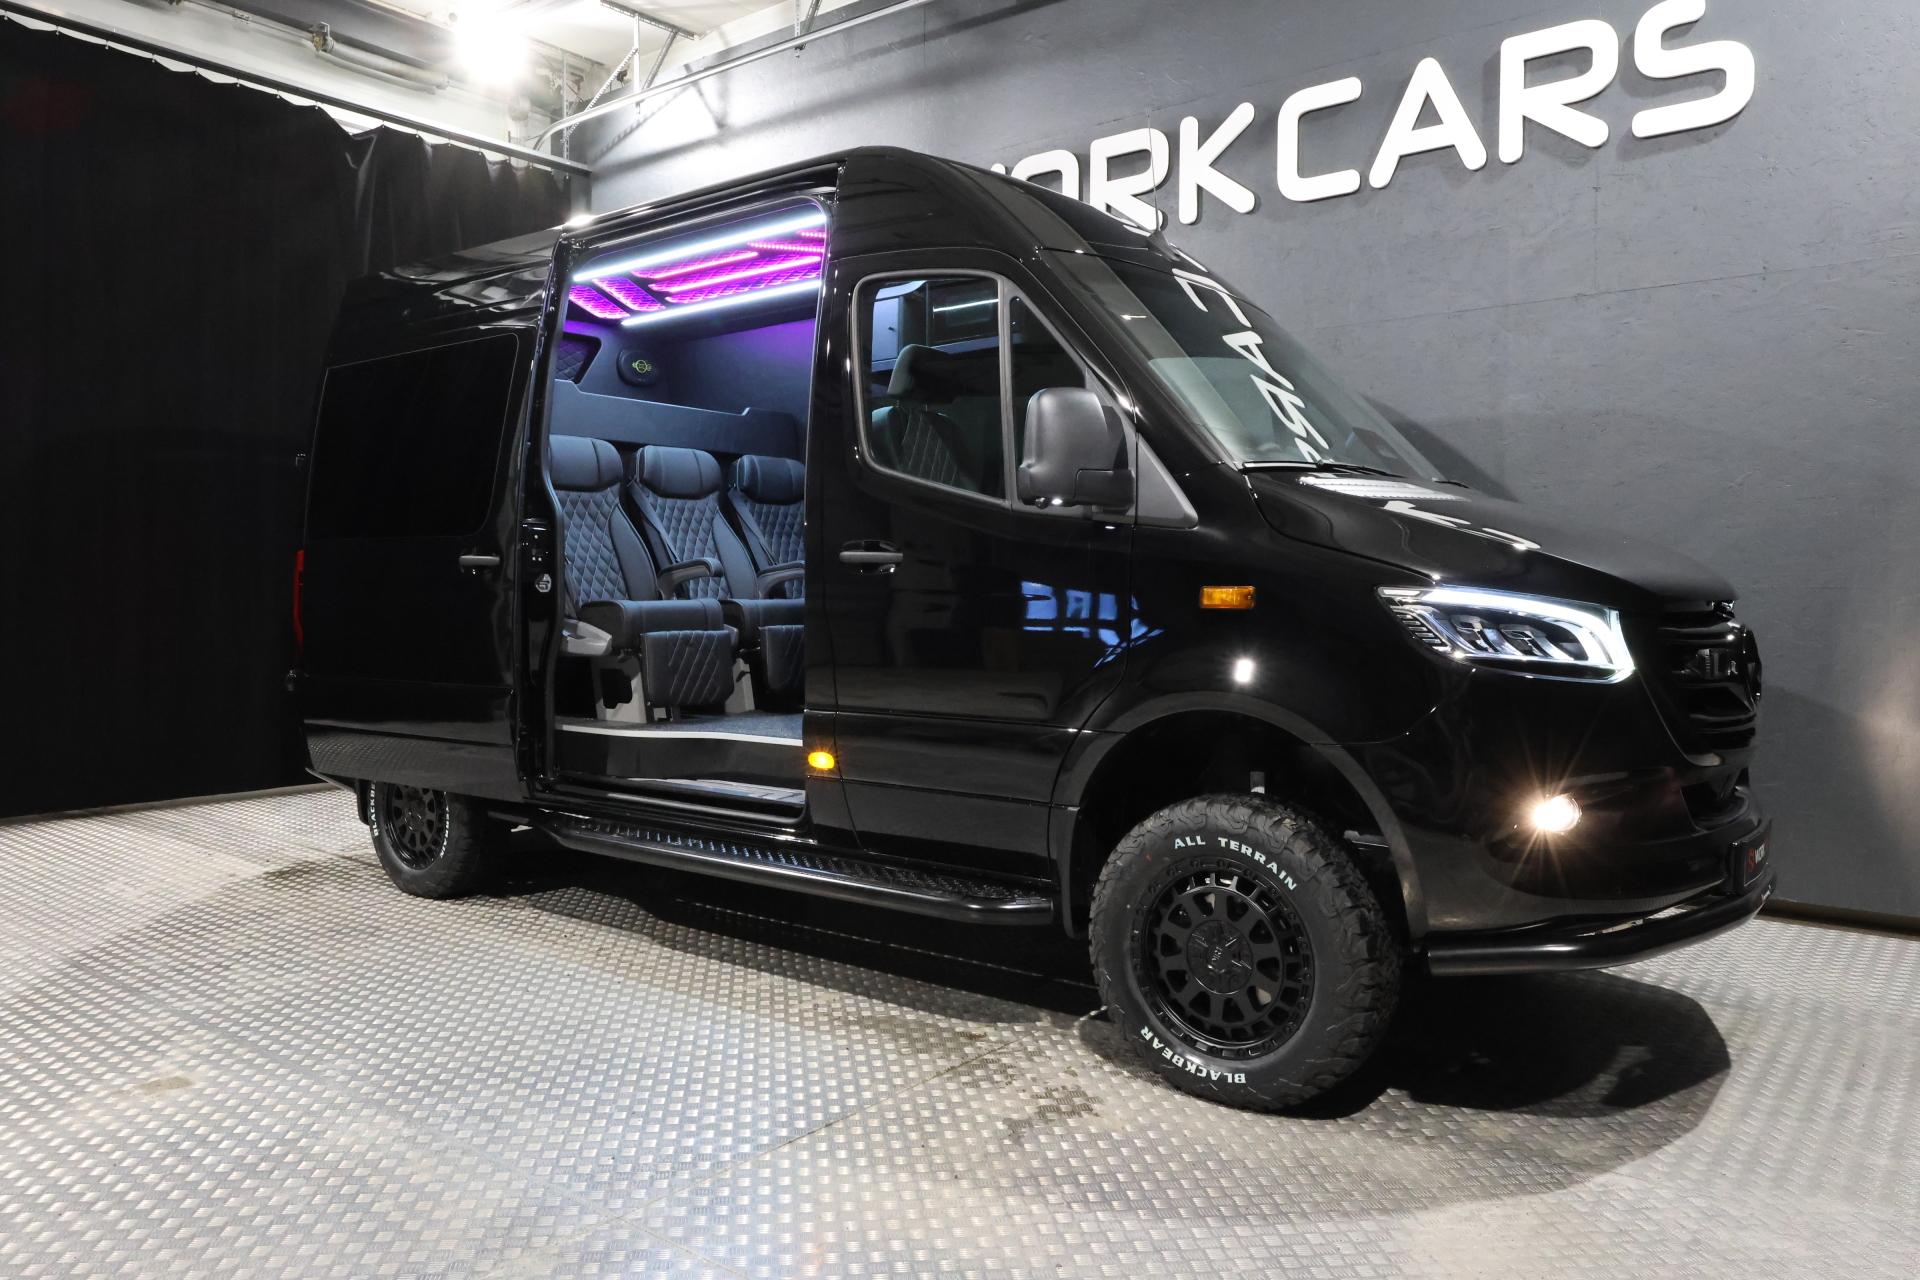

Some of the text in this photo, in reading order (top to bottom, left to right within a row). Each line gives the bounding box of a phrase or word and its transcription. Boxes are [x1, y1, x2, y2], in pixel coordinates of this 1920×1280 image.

[1174, 835, 1298, 890] ALL TERRAIN
[1140, 1026, 1247, 1084] BLACKBEAR
